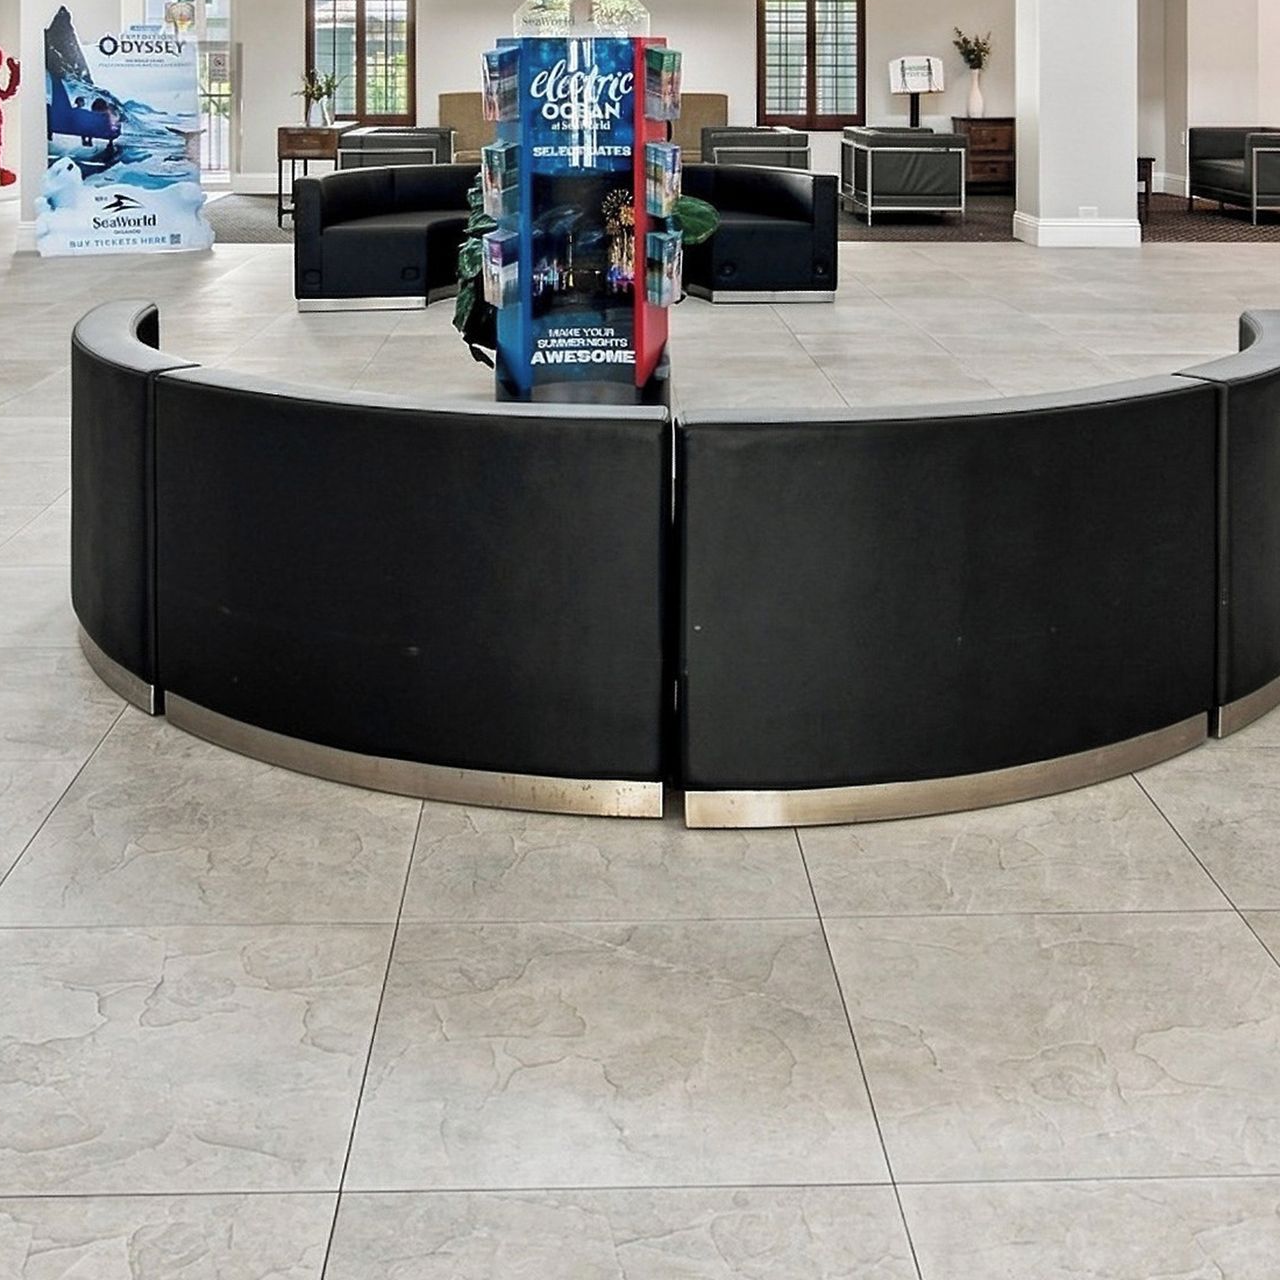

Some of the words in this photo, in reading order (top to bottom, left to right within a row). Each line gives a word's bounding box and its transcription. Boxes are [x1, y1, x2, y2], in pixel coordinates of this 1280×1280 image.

[98, 35, 187, 56] ODYSSEY
[92, 214, 157, 229] SeaWorld
[70, 240, 90, 248] BUY
[94, 238, 138, 247] TICKETS
[140, 236, 167, 245] HERE
[548, 328, 581, 337] MAKE
[582, 327, 615, 337] YOUR
[537, 338, 586, 349] SUMMER
[587, 338, 628, 347] NIGHTS
[530, 350, 636, 365] AWESOME
